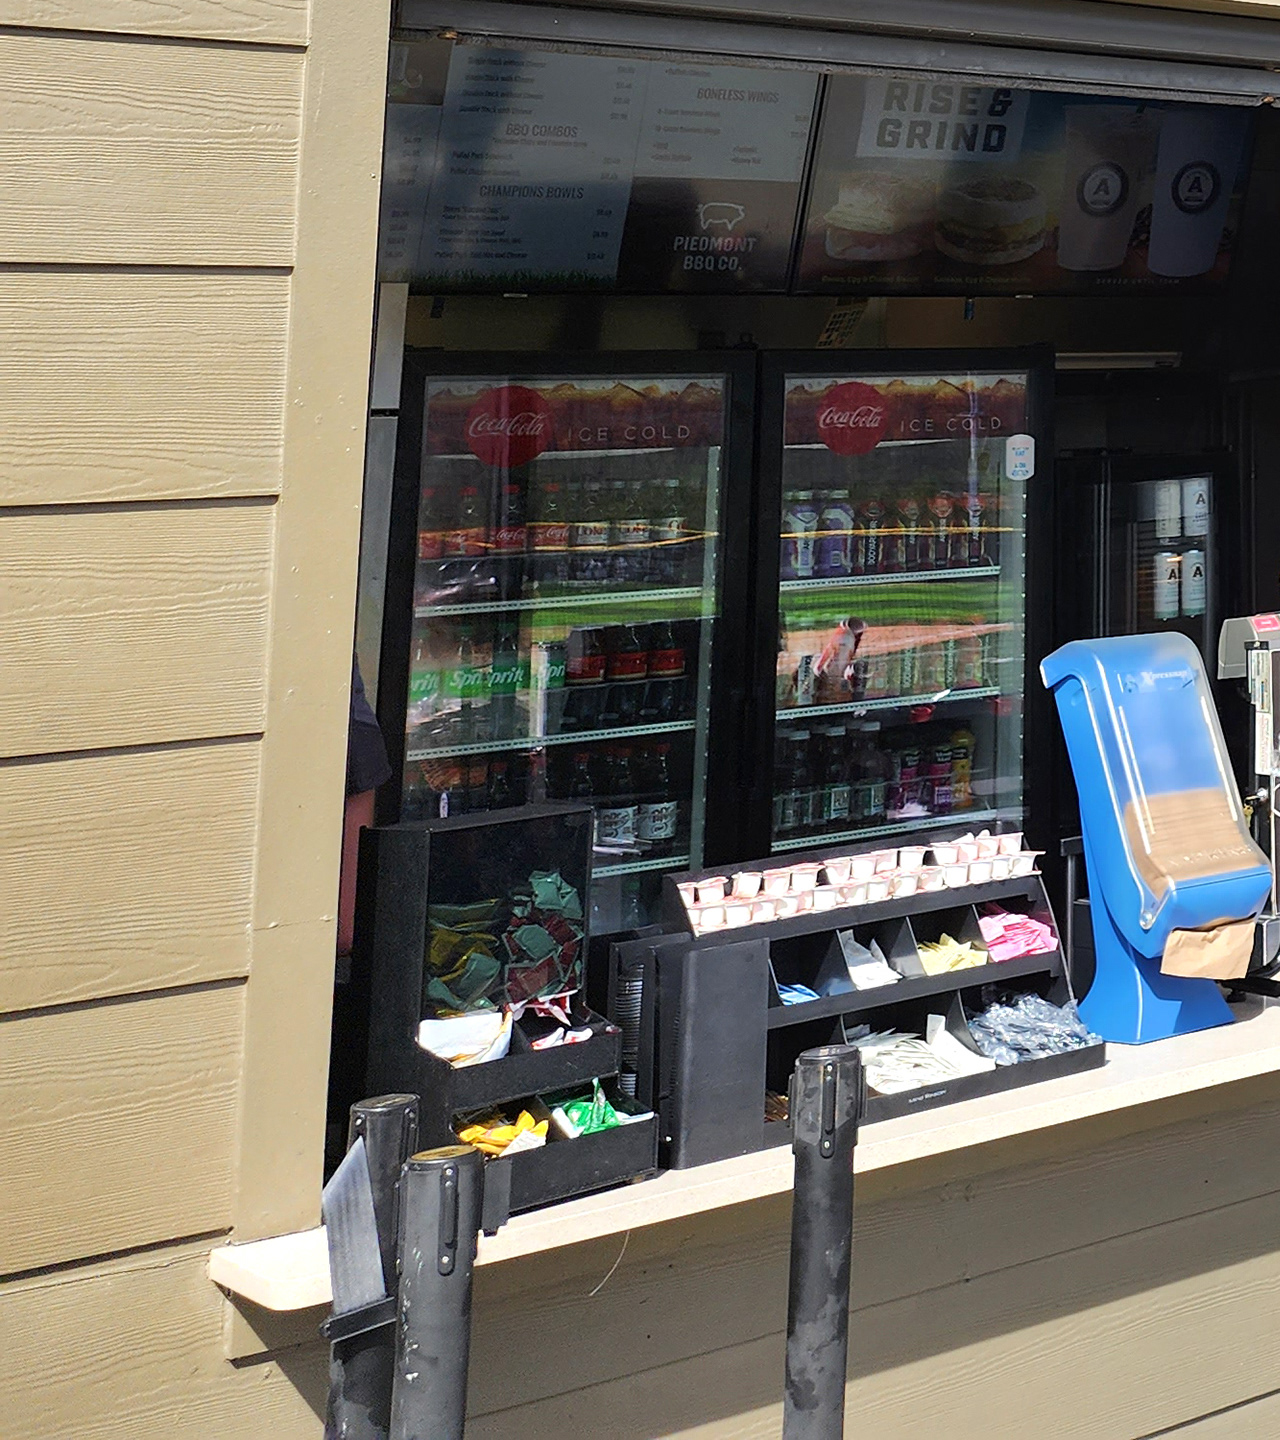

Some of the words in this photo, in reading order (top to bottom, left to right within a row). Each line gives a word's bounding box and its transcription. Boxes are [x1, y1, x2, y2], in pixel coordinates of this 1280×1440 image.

[697, 88, 746, 103] BONELESS
[747, 90, 780, 104] WINGS
[883, 82, 981, 116] RISE
[987, 88, 1013, 117] &
[531, 124, 579, 139] COMBOS
[876, 117, 1008, 153] GRIND
[479, 184, 544, 198] CHAMPIONS
[545, 186, 585, 200] BOWLS
[1188, 176, 1204, 194] A
[673, 235, 757, 254] PIEDMONT
[683, 256, 715, 271] BBQ
[900, 418, 935, 433] ICE
[945, 416, 1001, 432] COLD
[567, 426, 609, 443] ICE
[624, 424, 691, 442] COLD
[1192, 566, 1204, 578] A
